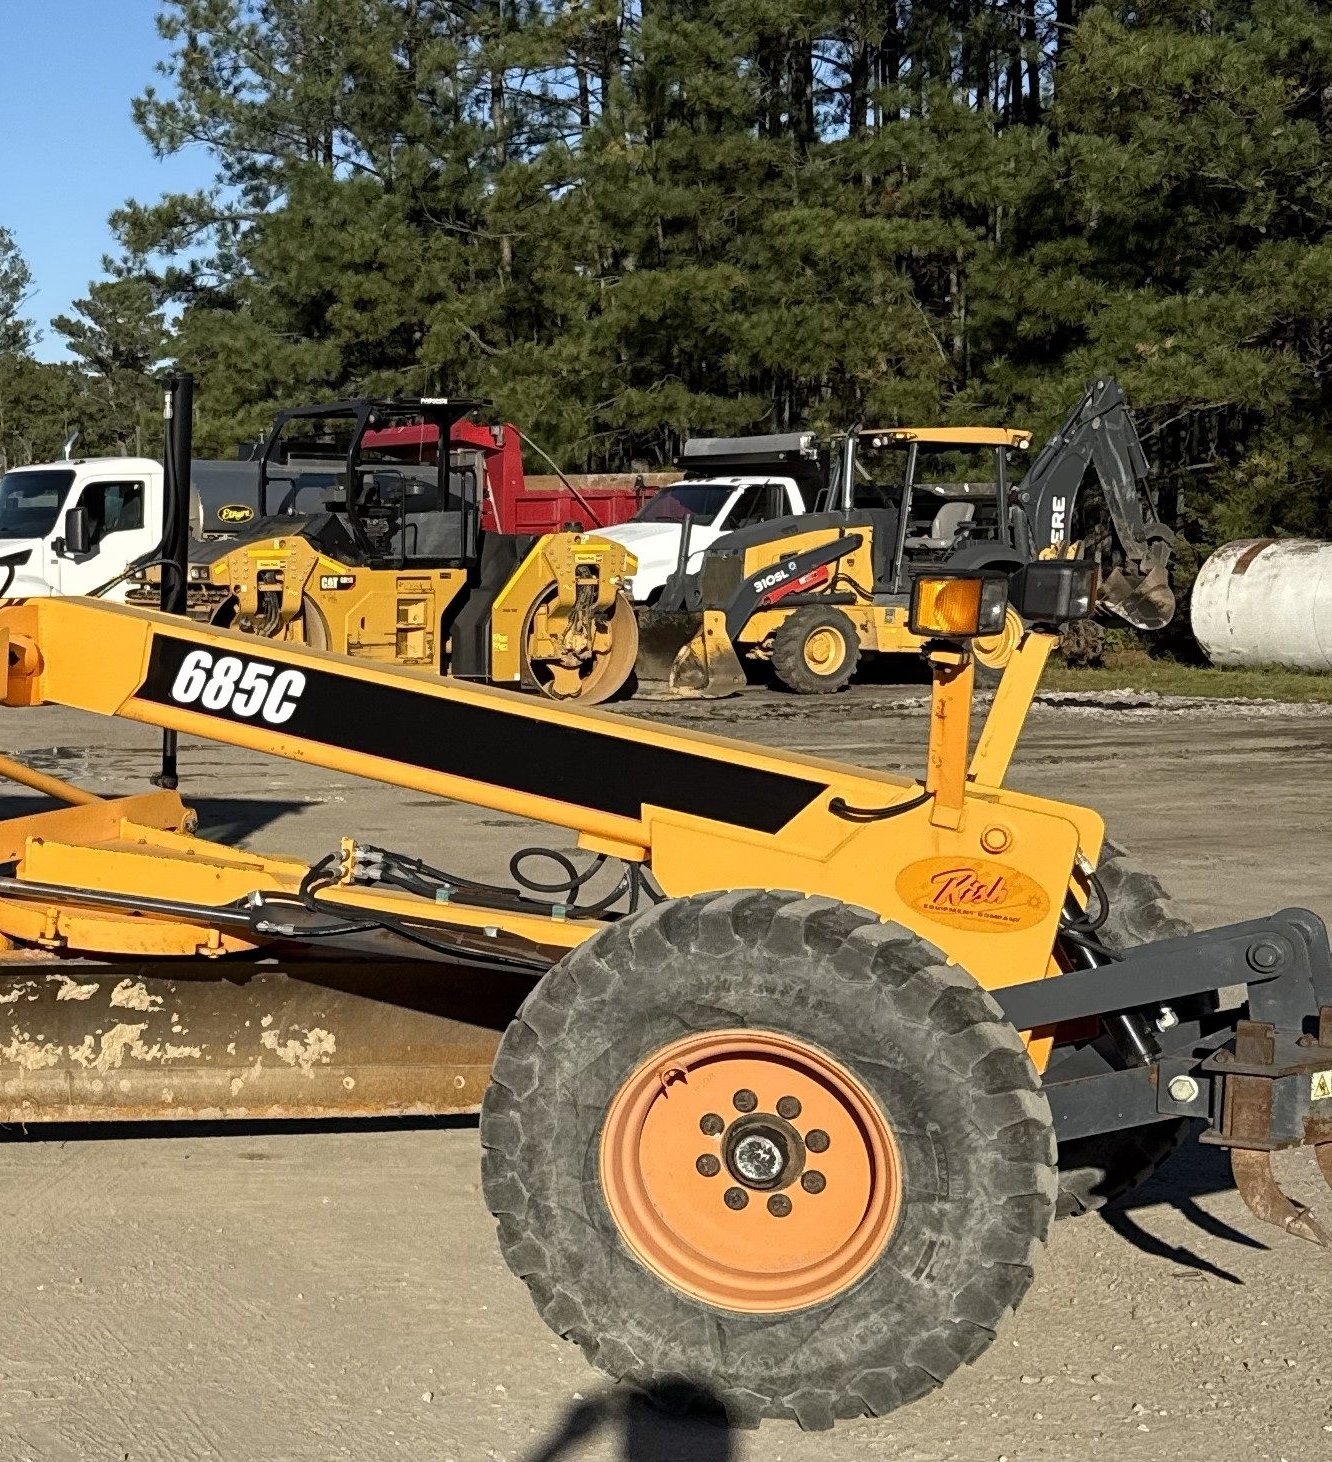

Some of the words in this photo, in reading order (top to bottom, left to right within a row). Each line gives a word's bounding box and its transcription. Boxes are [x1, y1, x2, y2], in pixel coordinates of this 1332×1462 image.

[1050, 496, 1066, 549] ERE
[321, 576, 339, 589] CAT
[753, 569, 790, 593] 310SL
[172, 650, 306, 724] 685C
[930, 868, 1008, 906] Rish
